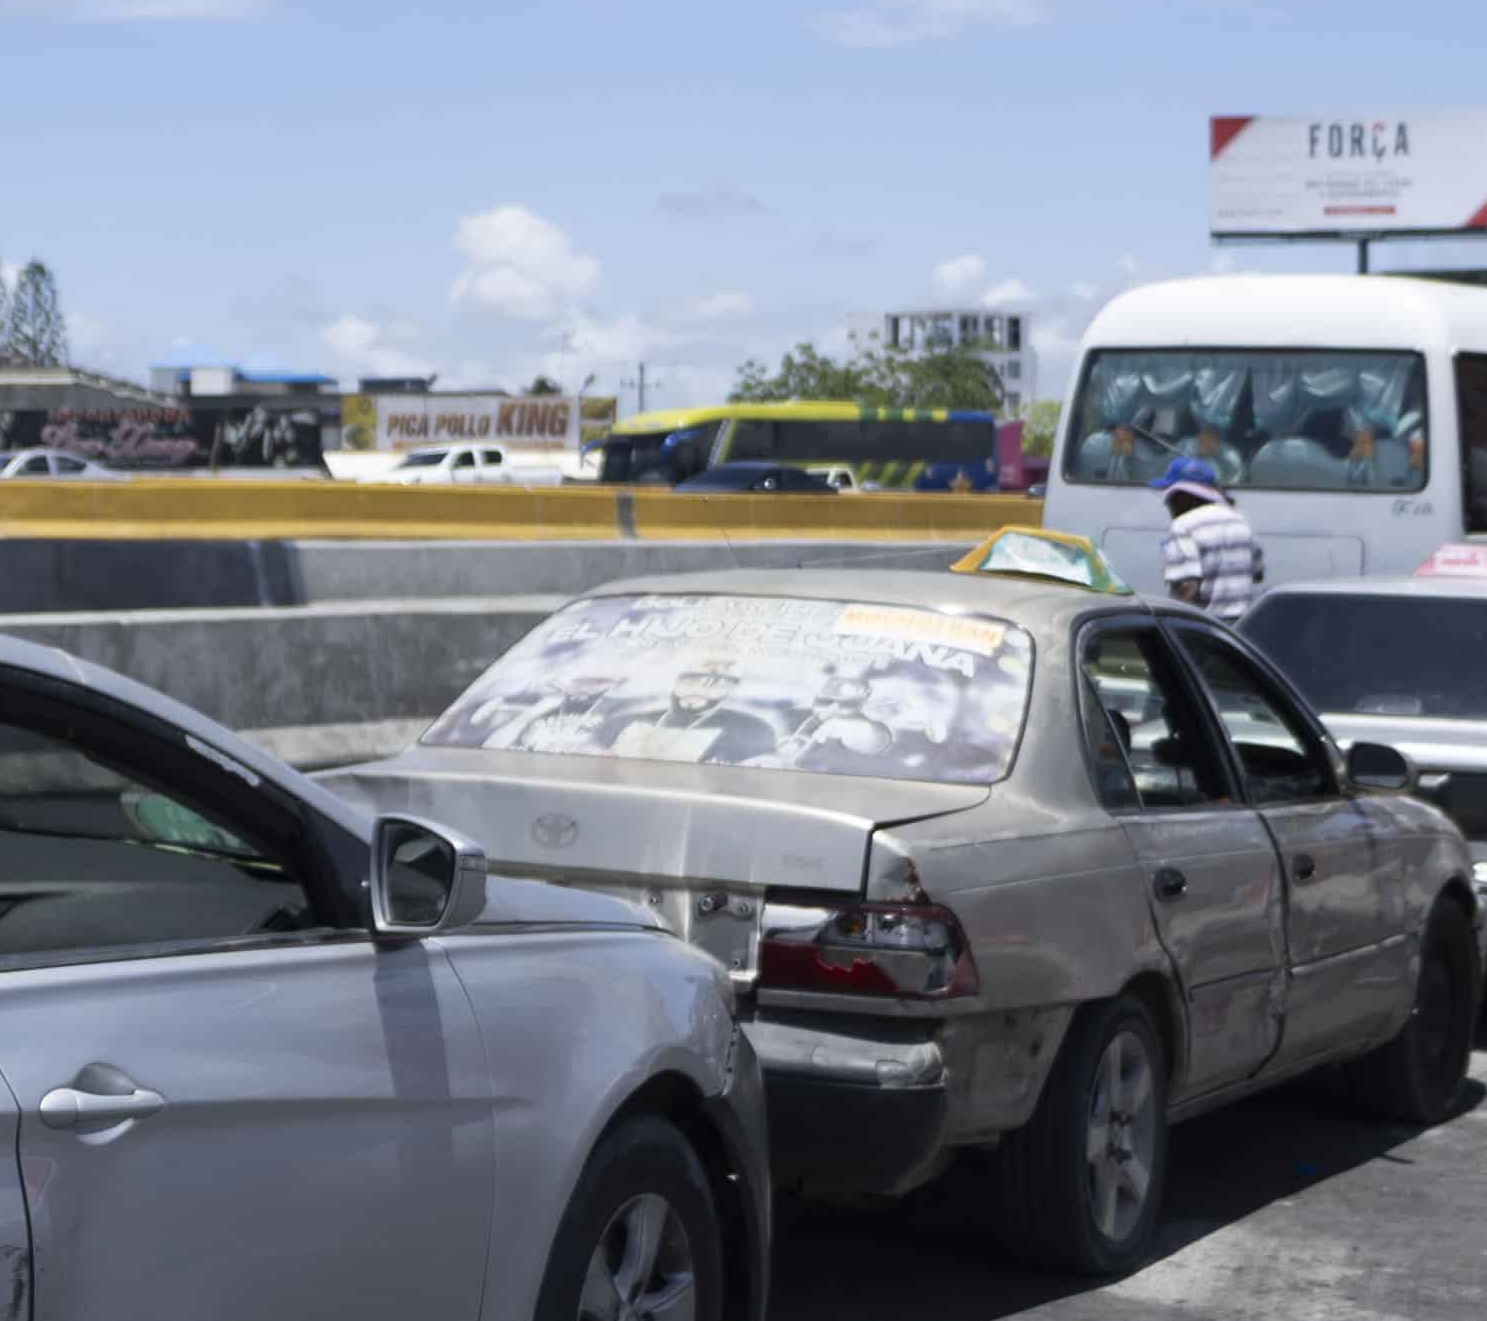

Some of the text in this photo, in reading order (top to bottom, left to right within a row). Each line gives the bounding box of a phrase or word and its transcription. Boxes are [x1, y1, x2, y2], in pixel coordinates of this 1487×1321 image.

[1309, 122, 1410, 163] FORÇA
[434, 413, 491, 438] POLLO
[495, 400, 571, 438] KING
[551, 621, 599, 642] EL
